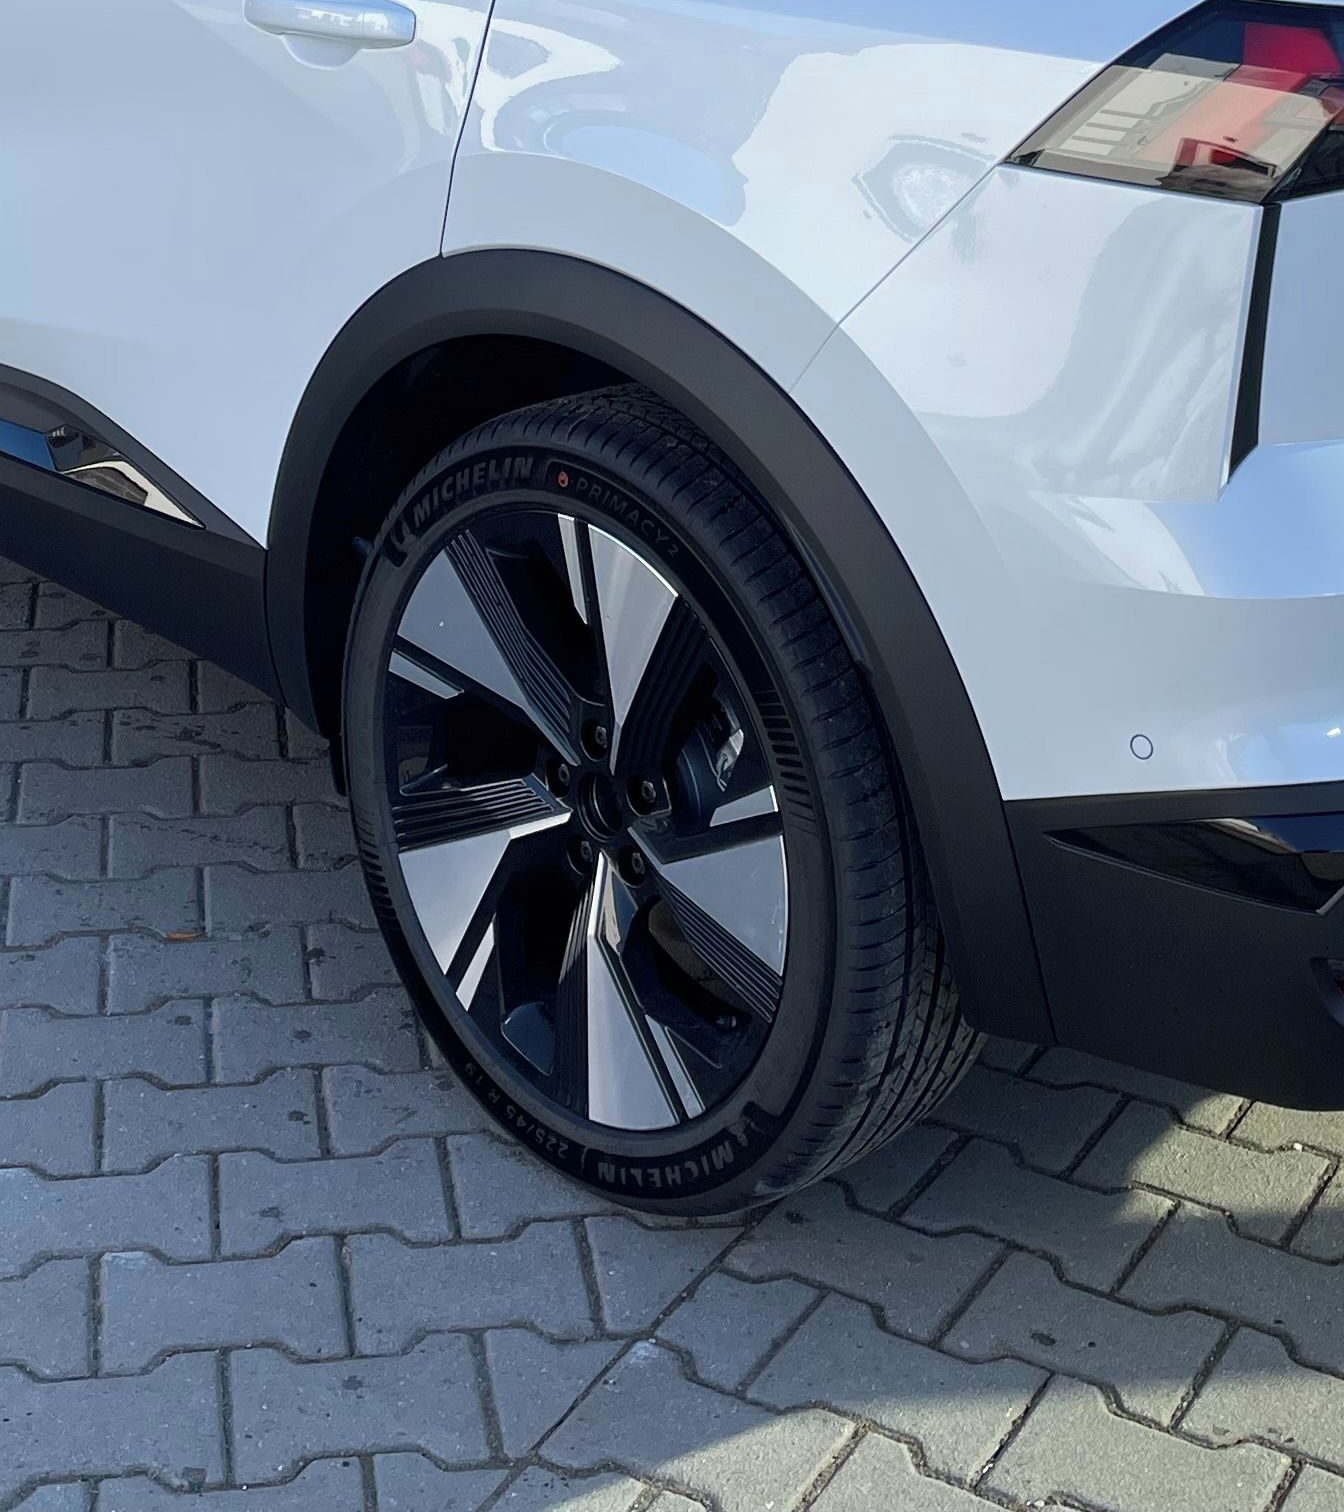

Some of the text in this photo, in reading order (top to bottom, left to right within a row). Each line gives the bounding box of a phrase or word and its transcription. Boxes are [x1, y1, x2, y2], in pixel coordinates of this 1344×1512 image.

[413, 455, 536, 527] MICHELIN
[575, 477, 672, 545] PRIMACY
[596, 1141, 737, 1188] MICHELIN
